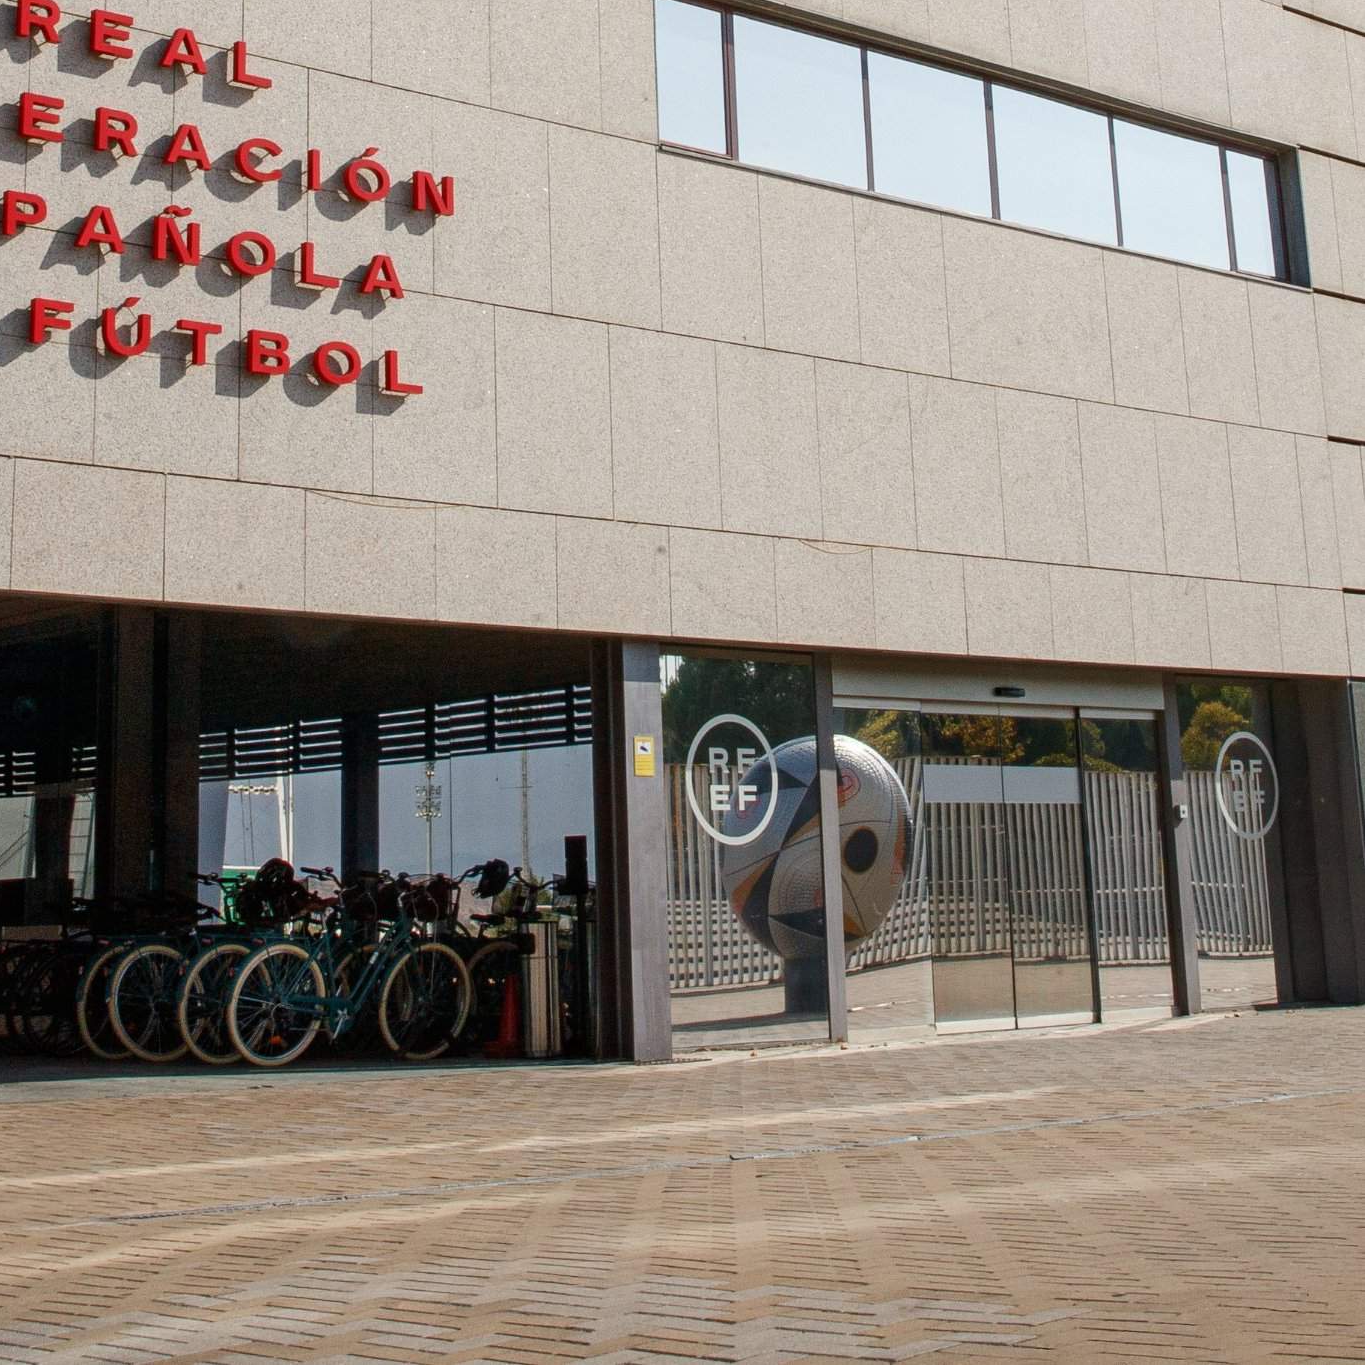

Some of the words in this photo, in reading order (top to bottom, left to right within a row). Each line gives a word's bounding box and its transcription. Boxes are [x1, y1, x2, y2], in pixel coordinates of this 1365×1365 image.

[29, 296, 424, 395] FÚTBOL
[708, 746, 756, 774] RF
[710, 784, 758, 811] EF
